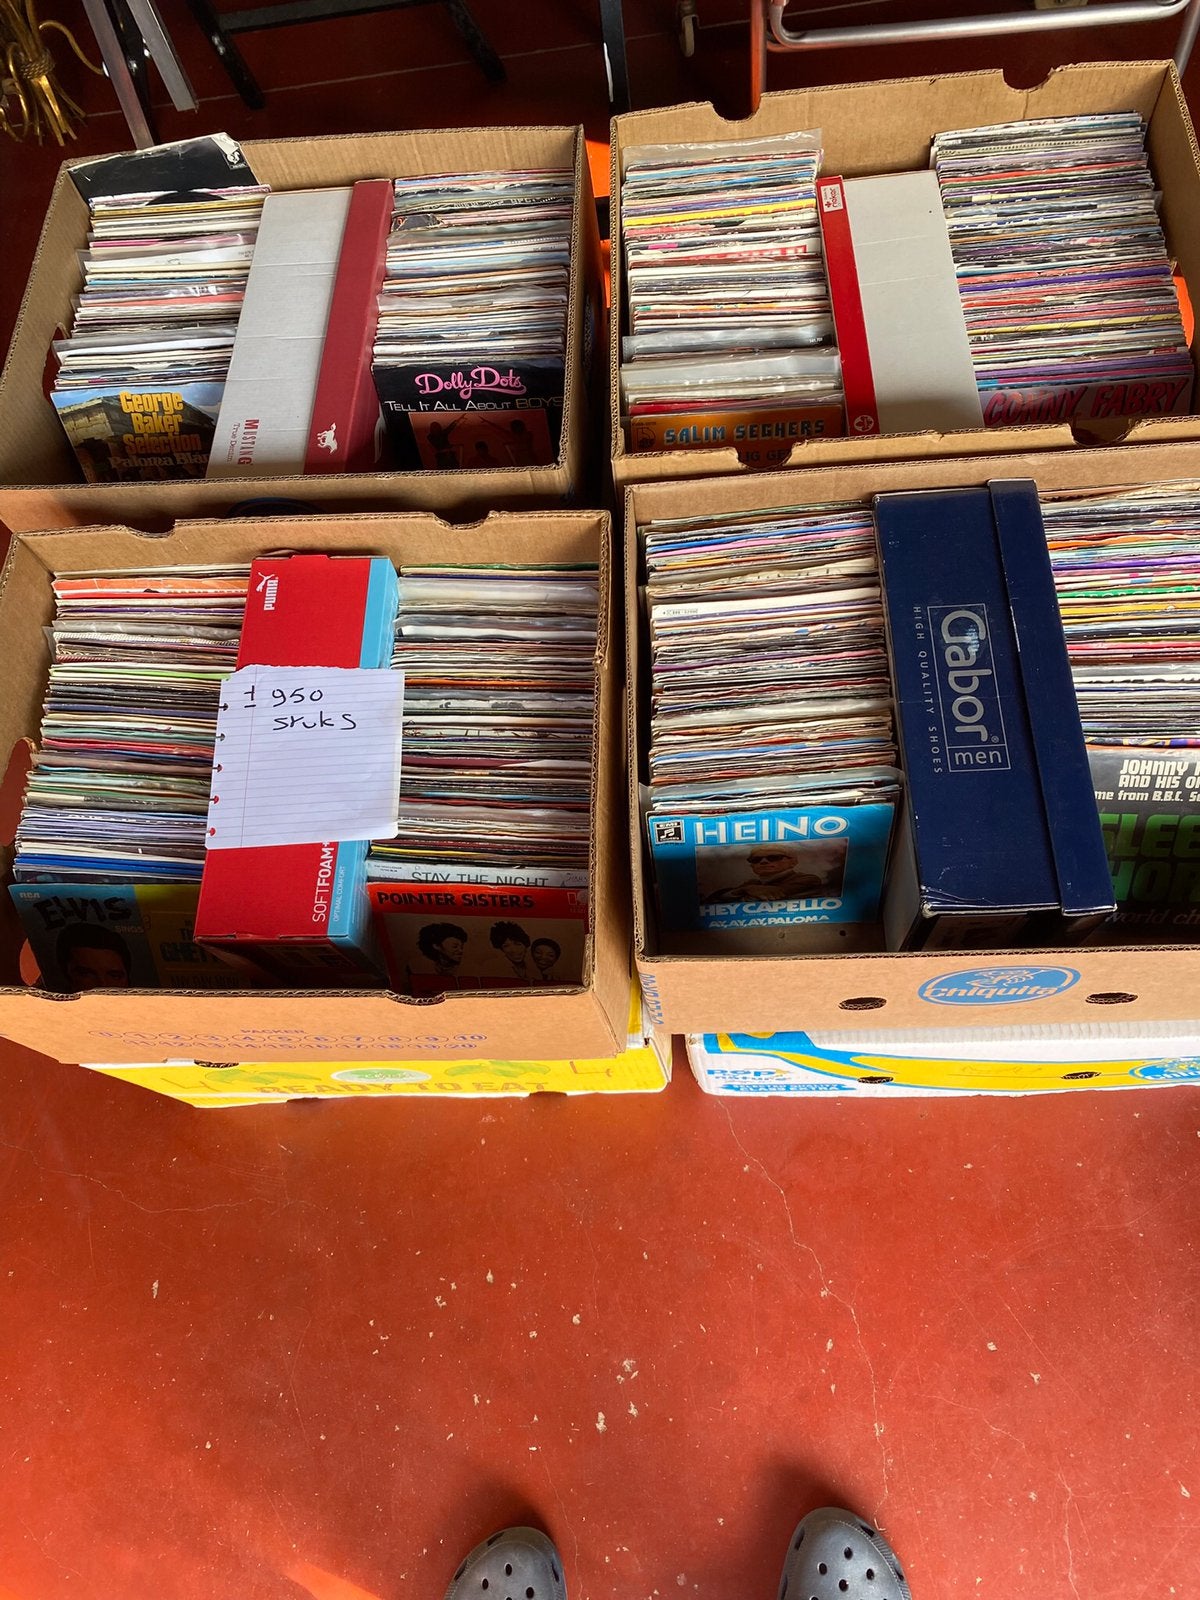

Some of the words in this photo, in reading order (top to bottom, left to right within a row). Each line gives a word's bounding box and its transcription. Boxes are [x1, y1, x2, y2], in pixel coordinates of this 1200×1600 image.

[414, 371, 473, 400] Dolly
[470, 366, 527, 396] Dots
[119, 390, 185, 415] George
[384, 400, 416, 412] TELL
[418, 401, 432, 411] IT
[434, 400, 461, 411] ALL
[465, 400, 512, 411] ABOUT
[515, 396, 563, 410] BOYS
[983, 386, 1088, 428] CONNY
[1090, 378, 1190, 418] FABRY
[131, 412, 184, 435] Baker
[664, 425, 726, 446] SALIM
[734, 419, 826, 442] SEGHERS
[122, 432, 203, 456] Selection
[237, 418, 260, 466] MUSTANG
[263, 578, 280, 611] PUMA
[912, 605, 926, 641] HIGH
[917, 650, 935, 715] QUALITY
[941, 609, 993, 743] Gabor
[271, 687, 324, 708] 950
[928, 725, 943, 774] SHOES
[954, 750, 1002, 766] men
[1118, 775, 1151, 788] AND
[1155, 775, 1182, 789] HIS
[1117, 789, 1149, 801] from
[1152, 790, 1184, 802] B.B.C.
[694, 815, 849, 845] HEINO
[411, 871, 451, 882] STAY
[456, 873, 489, 884] THE
[496, 875, 549, 886] NIGHT
[33, 895, 132, 930] ELVIS
[377, 892, 455, 907] POINTER
[461, 893, 534, 909] SISTERS
[700, 902, 740, 917] HEY
[742, 897, 843, 914] CAPELLO
[767, 914, 830, 925] PALOMA
[923, 984, 1059, 999] Chiquita
[253, 1083, 393, 1094] READY
[405, 1081, 462, 1092] TO
[472, 1082, 549, 1091] EAT
